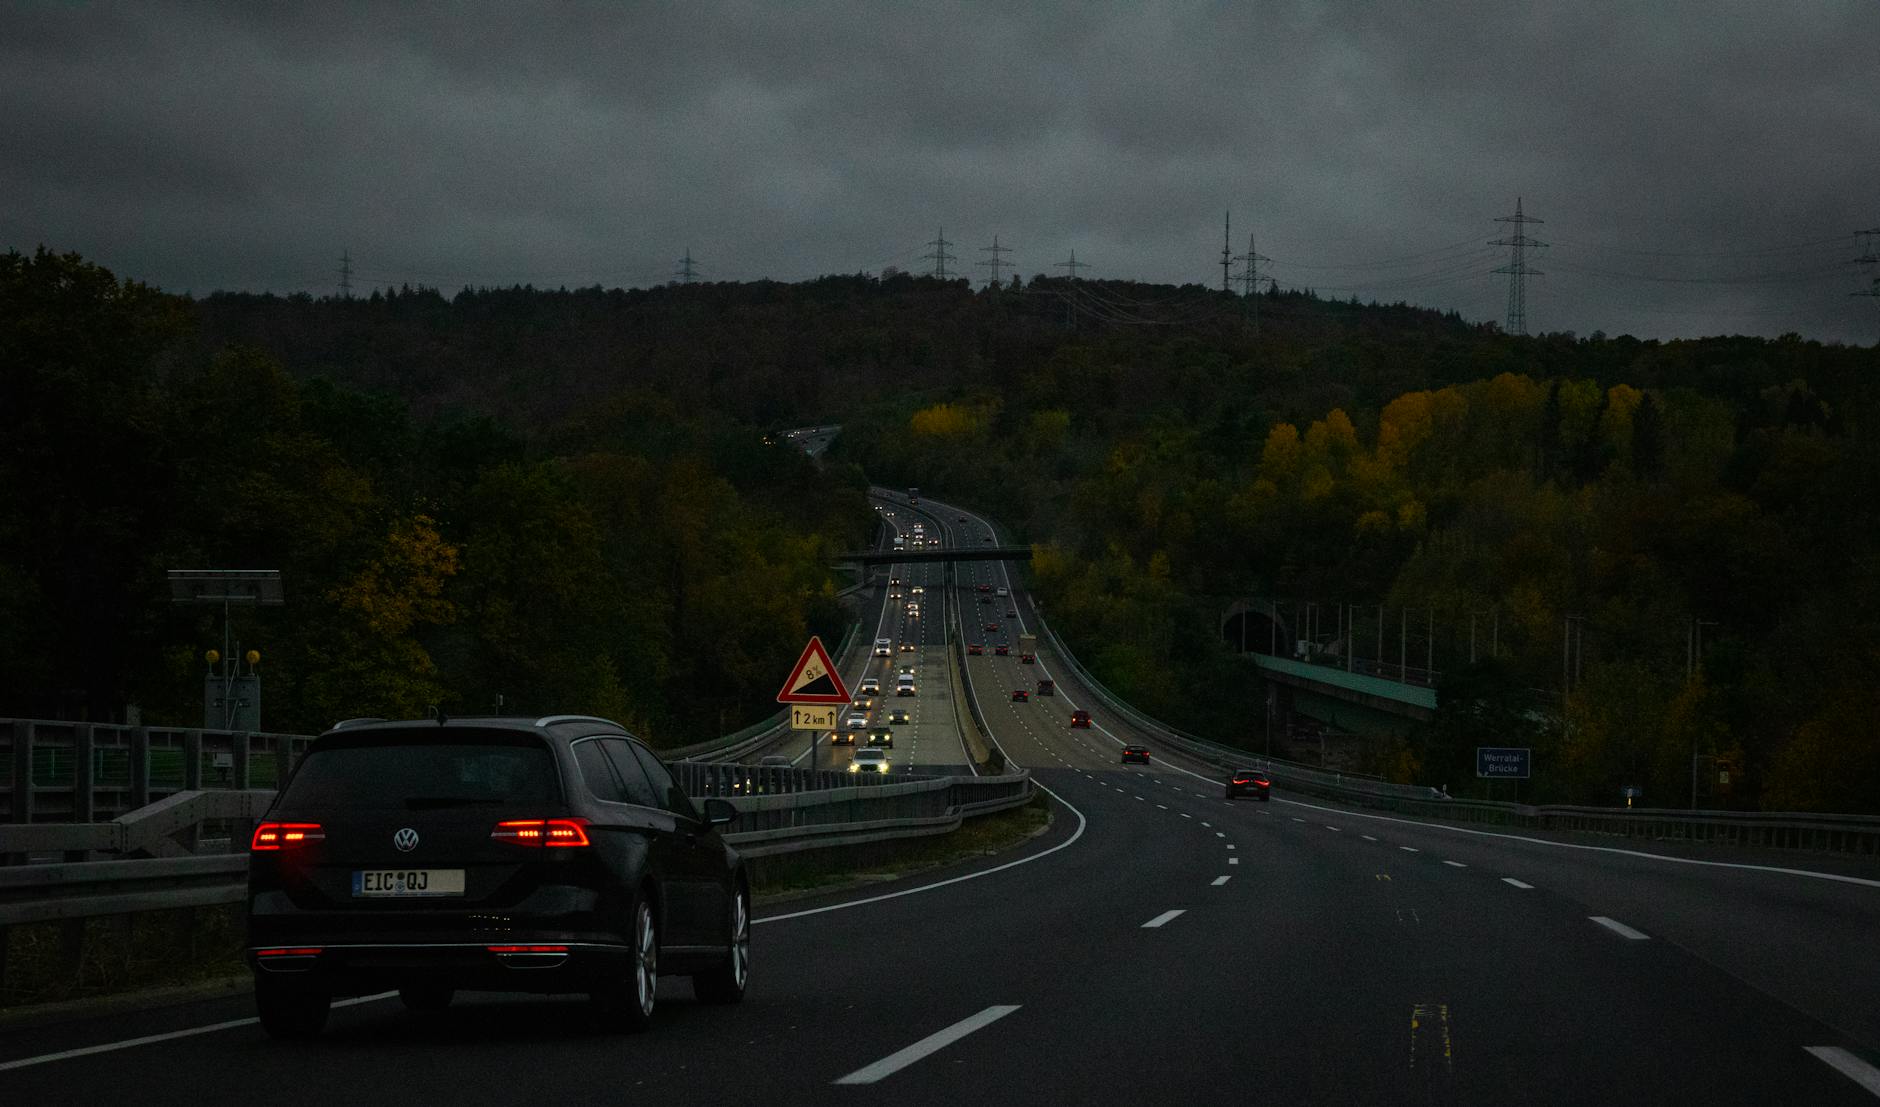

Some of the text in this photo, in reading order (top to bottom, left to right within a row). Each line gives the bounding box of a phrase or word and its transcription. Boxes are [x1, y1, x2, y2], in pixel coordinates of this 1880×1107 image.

[804, 713, 825, 724] 2 km
[365, 872, 428, 890] EIC QJ
